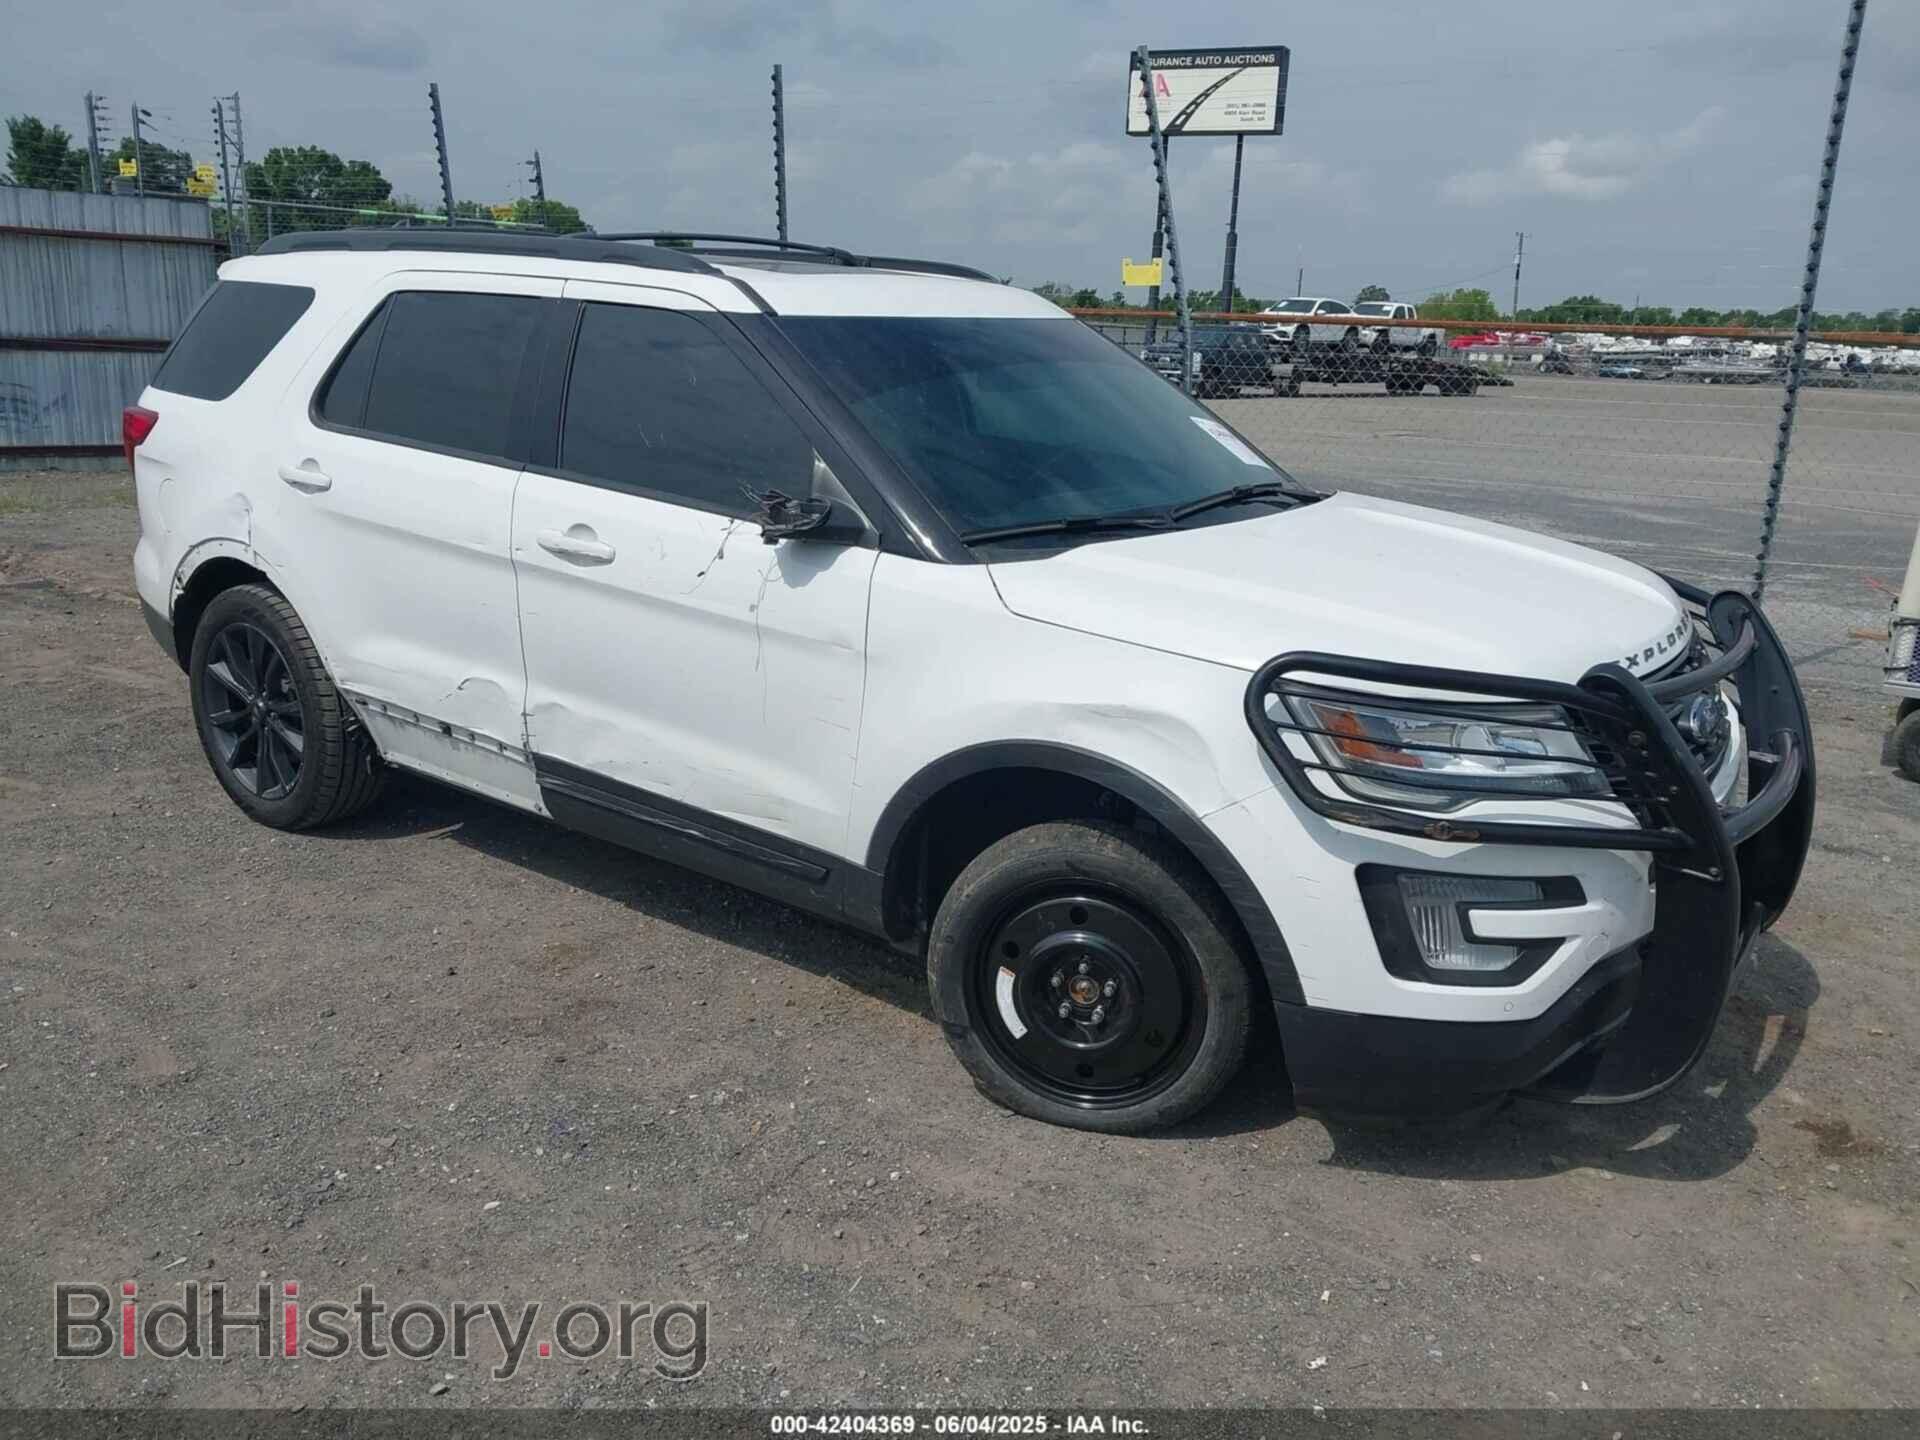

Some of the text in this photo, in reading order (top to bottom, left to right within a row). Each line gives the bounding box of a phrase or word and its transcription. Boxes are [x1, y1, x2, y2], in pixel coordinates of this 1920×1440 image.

[1147, 53, 1275, 67] SURANCE AUTO AUCTIONS
